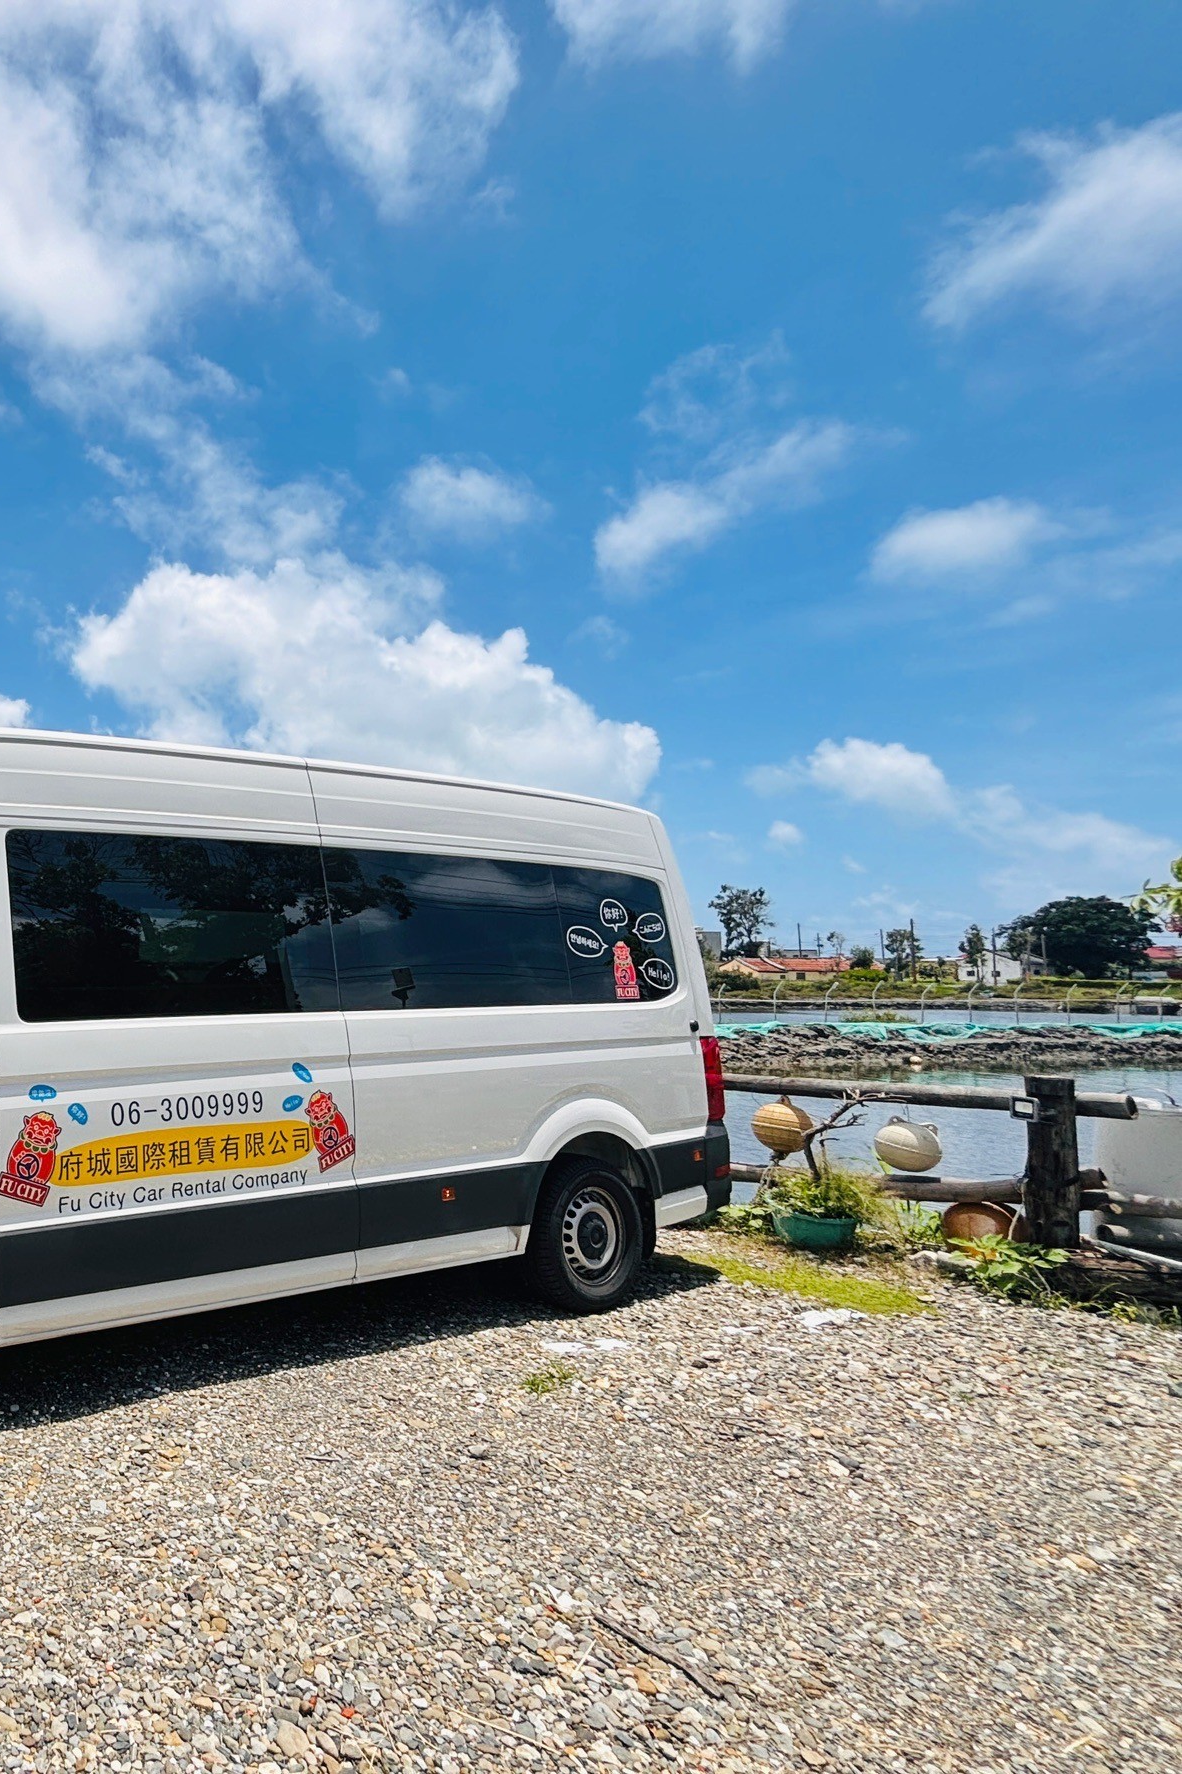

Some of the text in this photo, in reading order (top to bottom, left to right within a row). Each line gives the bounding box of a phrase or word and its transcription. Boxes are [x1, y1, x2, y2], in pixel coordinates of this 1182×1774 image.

[648, 966, 670, 982] Hello!
[111, 1091, 263, 1127] 06-3009999
[58, 1127, 310, 1181] 府城國際租賃有限公司
[58, 1169, 308, 1214] Fu City Car Rental Company
